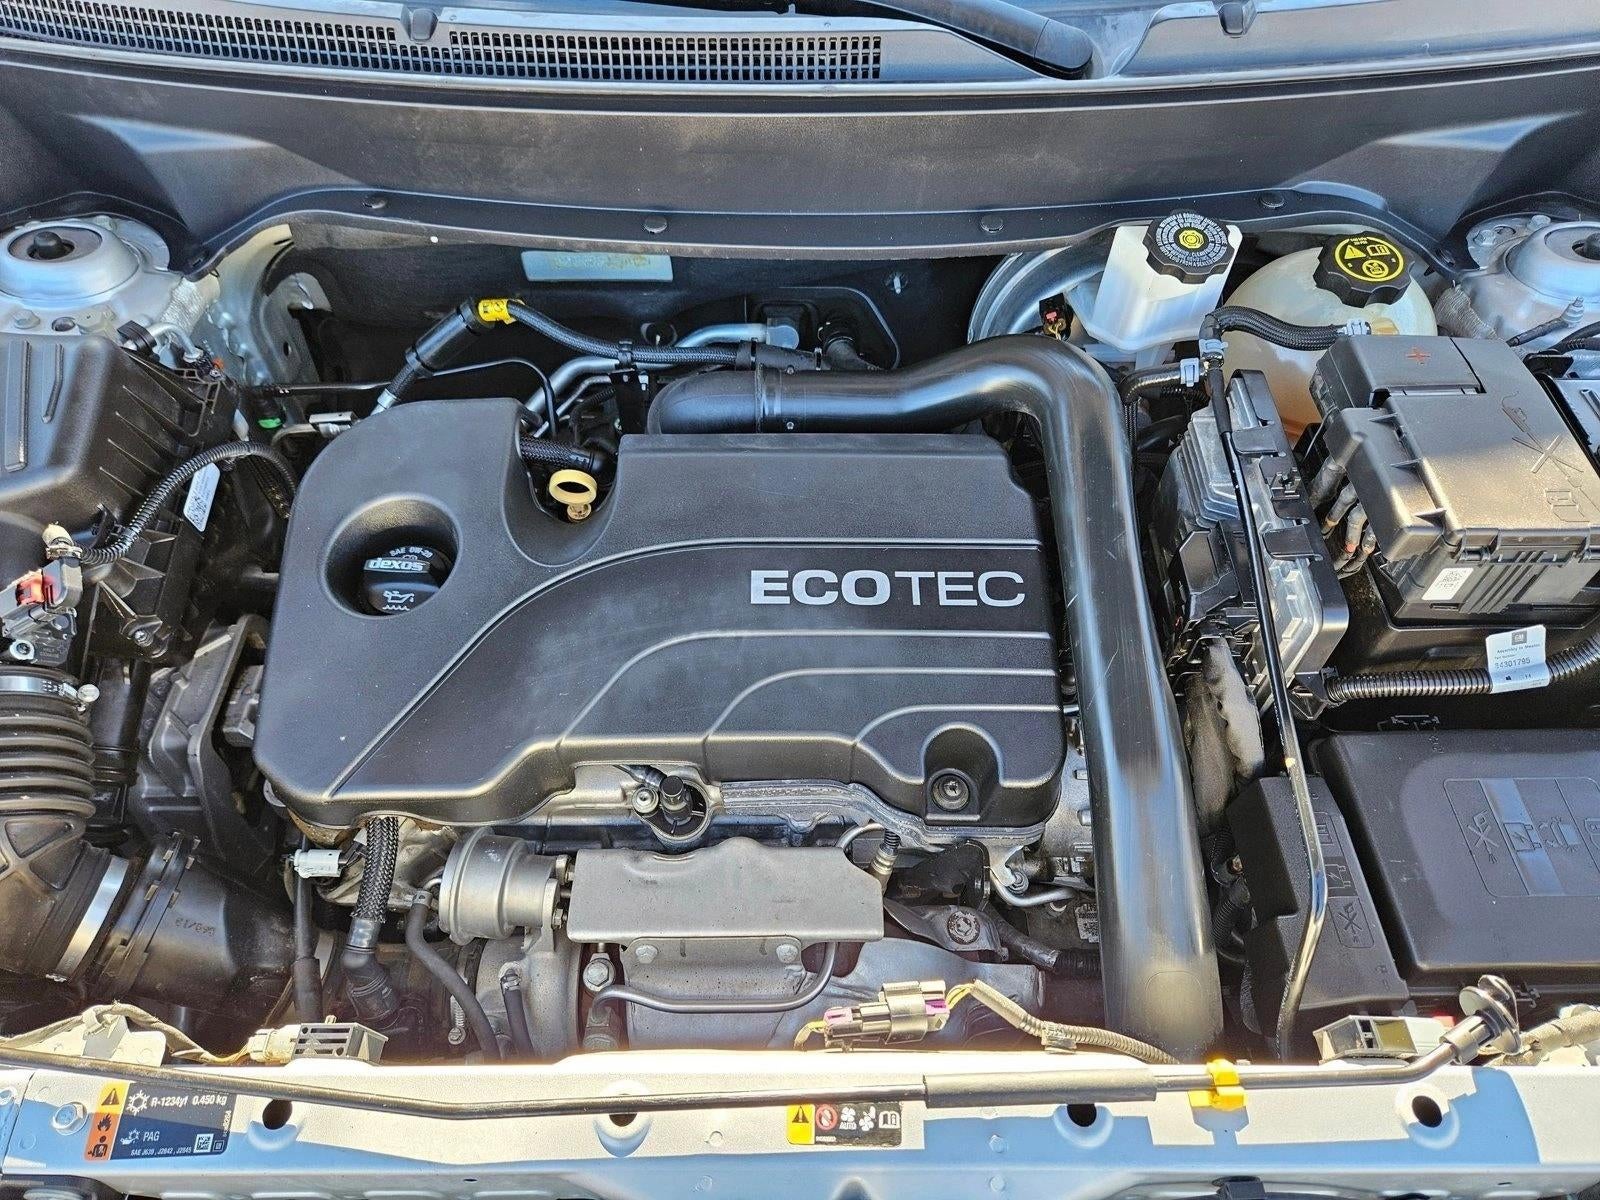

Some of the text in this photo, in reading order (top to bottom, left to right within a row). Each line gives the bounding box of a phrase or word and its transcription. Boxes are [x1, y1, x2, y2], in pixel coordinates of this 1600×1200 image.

[389, 547, 406, 557] SAE
[368, 558, 424, 571] dexos
[750, 569, 1026, 608] ECOTEC
[192, 1095, 215, 1105] 0.450
[215, 1095, 228, 1106] kg
[142, 1131, 160, 1142] PAG
